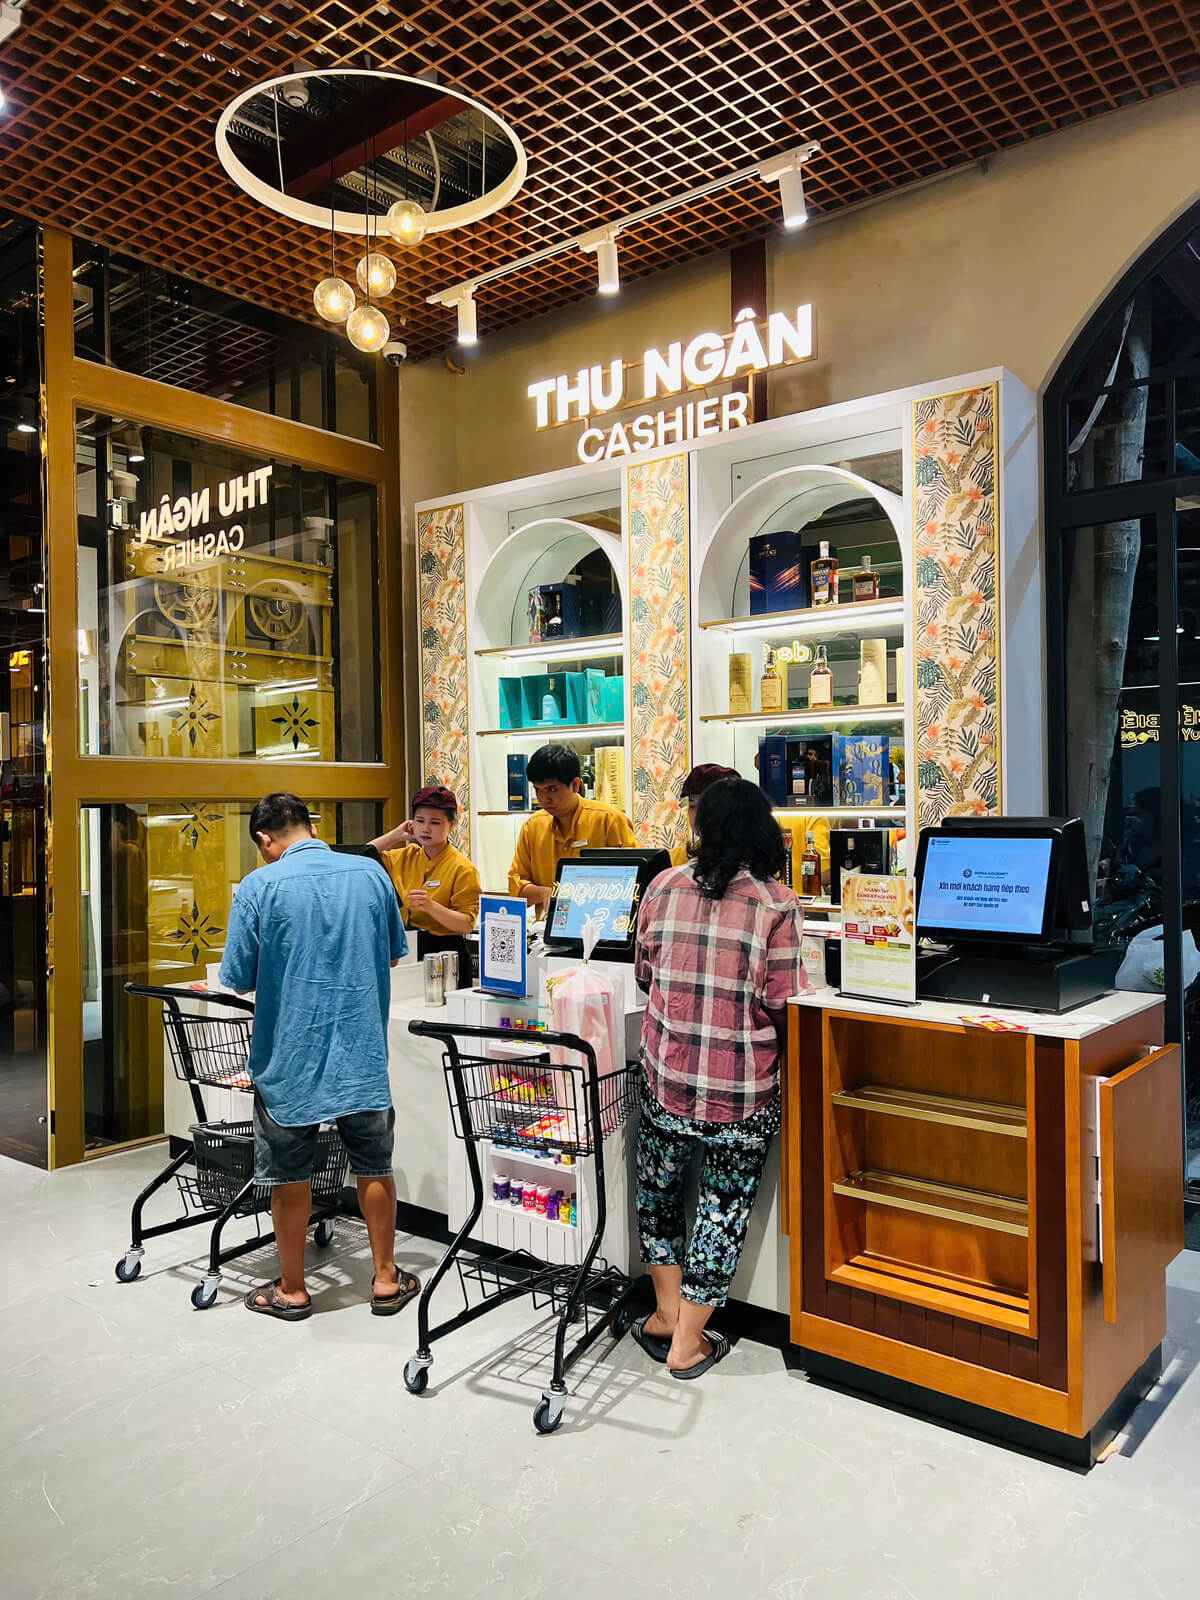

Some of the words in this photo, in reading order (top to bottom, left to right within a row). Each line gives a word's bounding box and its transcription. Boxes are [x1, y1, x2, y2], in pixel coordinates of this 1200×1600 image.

[527, 359, 624, 428] THU
[643, 303, 813, 398] NGÂN
[577, 391, 748, 464] CASHIER
